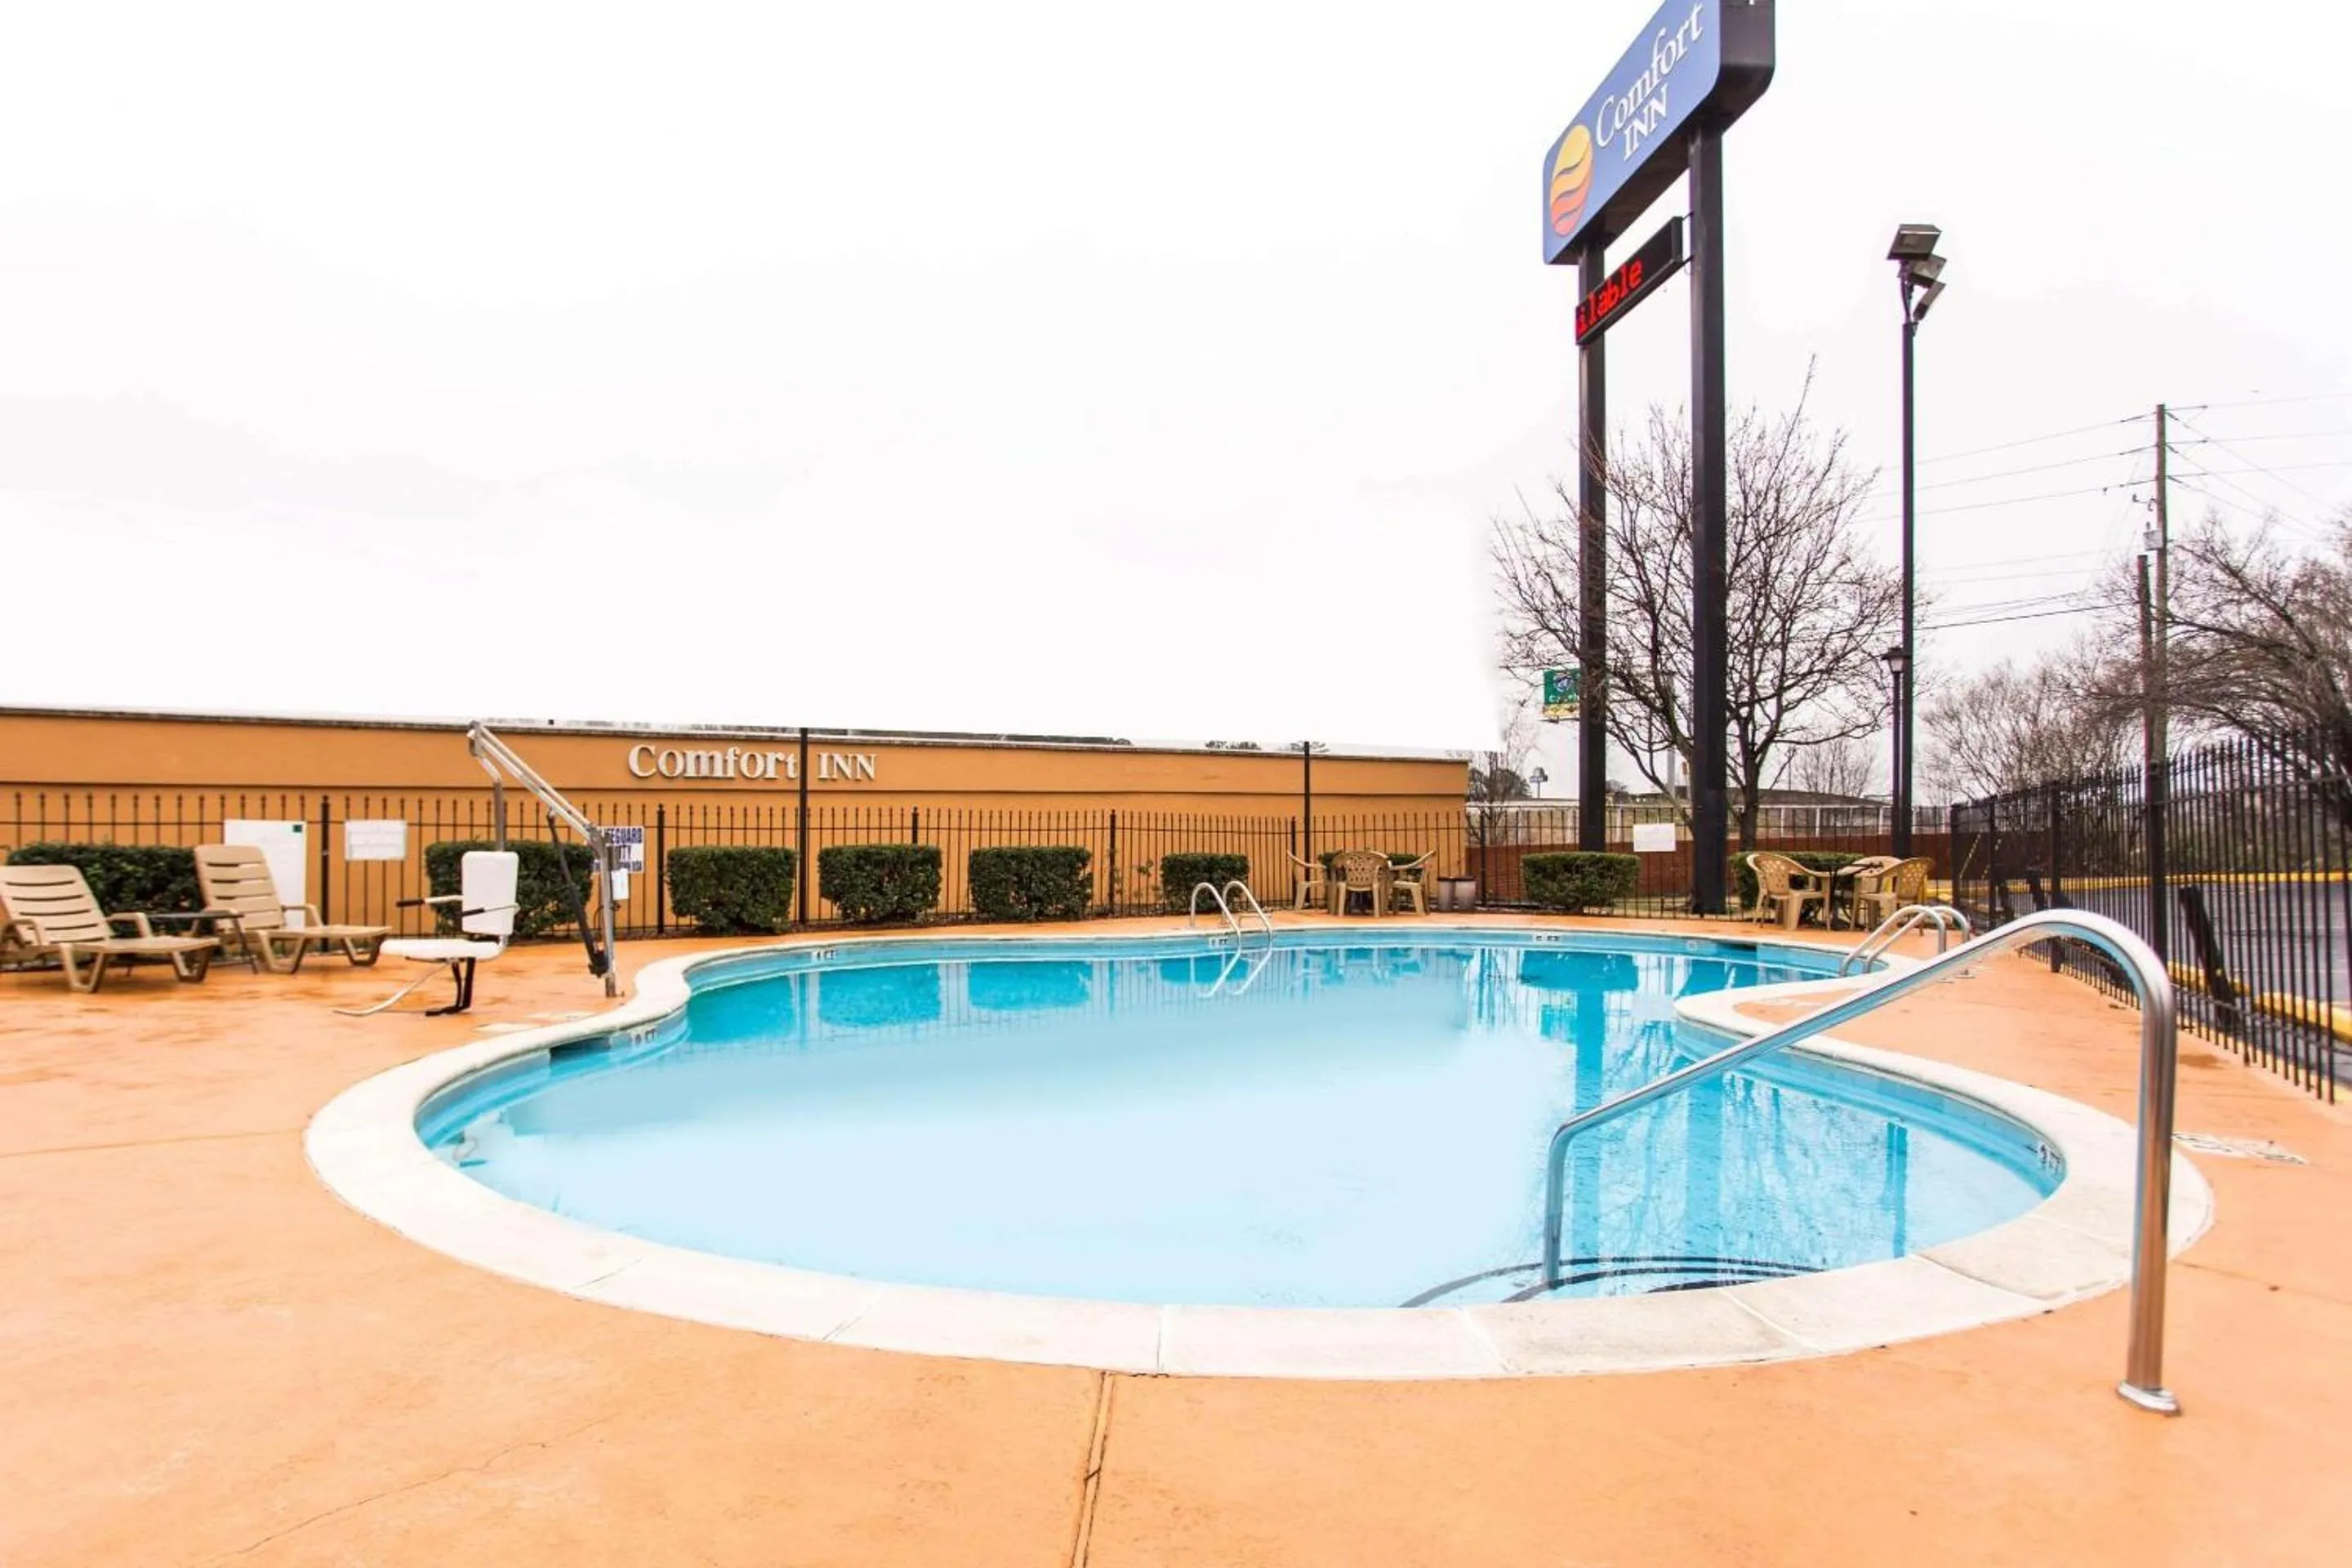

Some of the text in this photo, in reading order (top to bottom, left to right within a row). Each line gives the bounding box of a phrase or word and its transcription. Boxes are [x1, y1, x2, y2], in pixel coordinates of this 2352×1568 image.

[1596, 2, 1704, 148] Comfort
[1624, 83, 1668, 162] INN
[627, 743, 877, 780] Comfort INN
